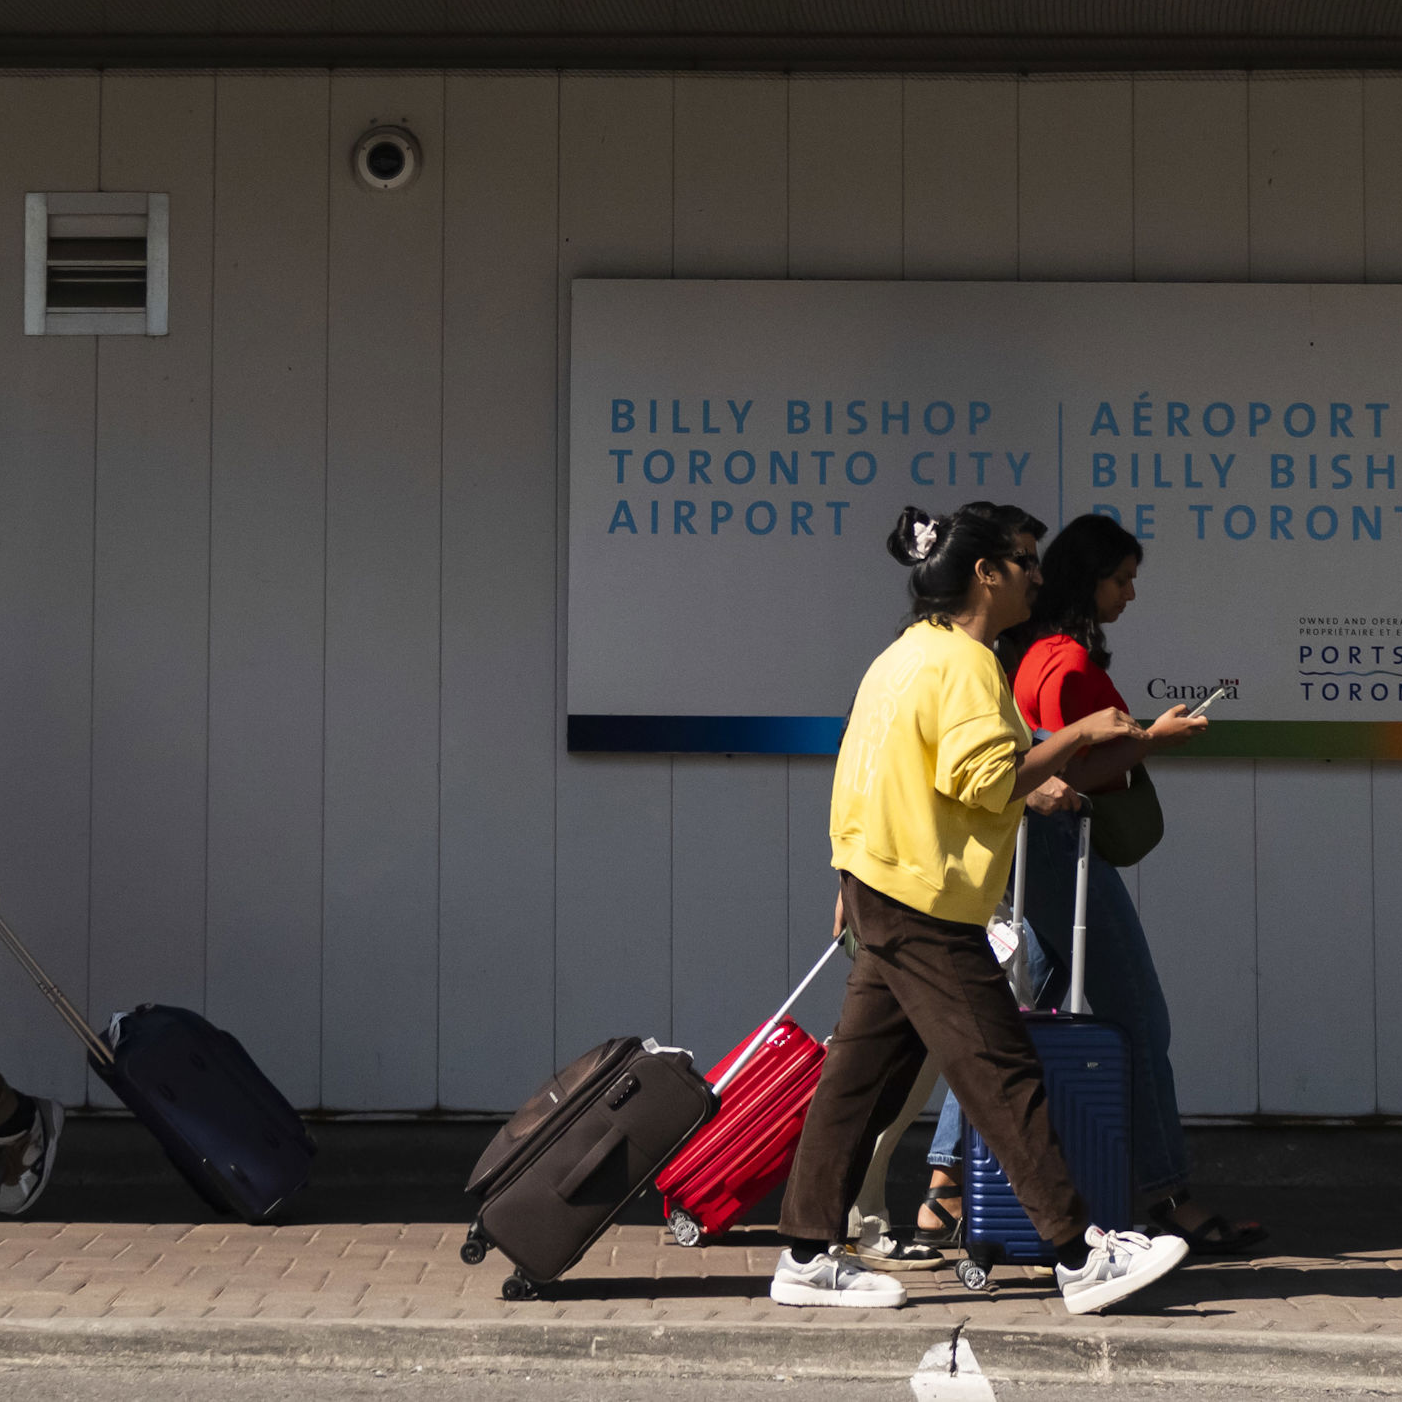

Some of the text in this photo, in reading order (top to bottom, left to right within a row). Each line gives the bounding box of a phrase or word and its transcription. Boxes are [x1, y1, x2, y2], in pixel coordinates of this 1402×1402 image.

[612, 399, 991, 435] BILLY BISHOP
[1090, 392, 1389, 438] AÉROPORT
[609, 449, 1030, 486] TORONTO CITY
[1093, 453, 1235, 488] BILLY
[608, 500, 850, 535] AIRPORT
[1299, 617, 1339, 626] OWNED
[1344, 617, 1367, 626] AND
[1299, 627, 1375, 636] PROPRIÉTAIRE
[1379, 628, 1391, 636] ET
